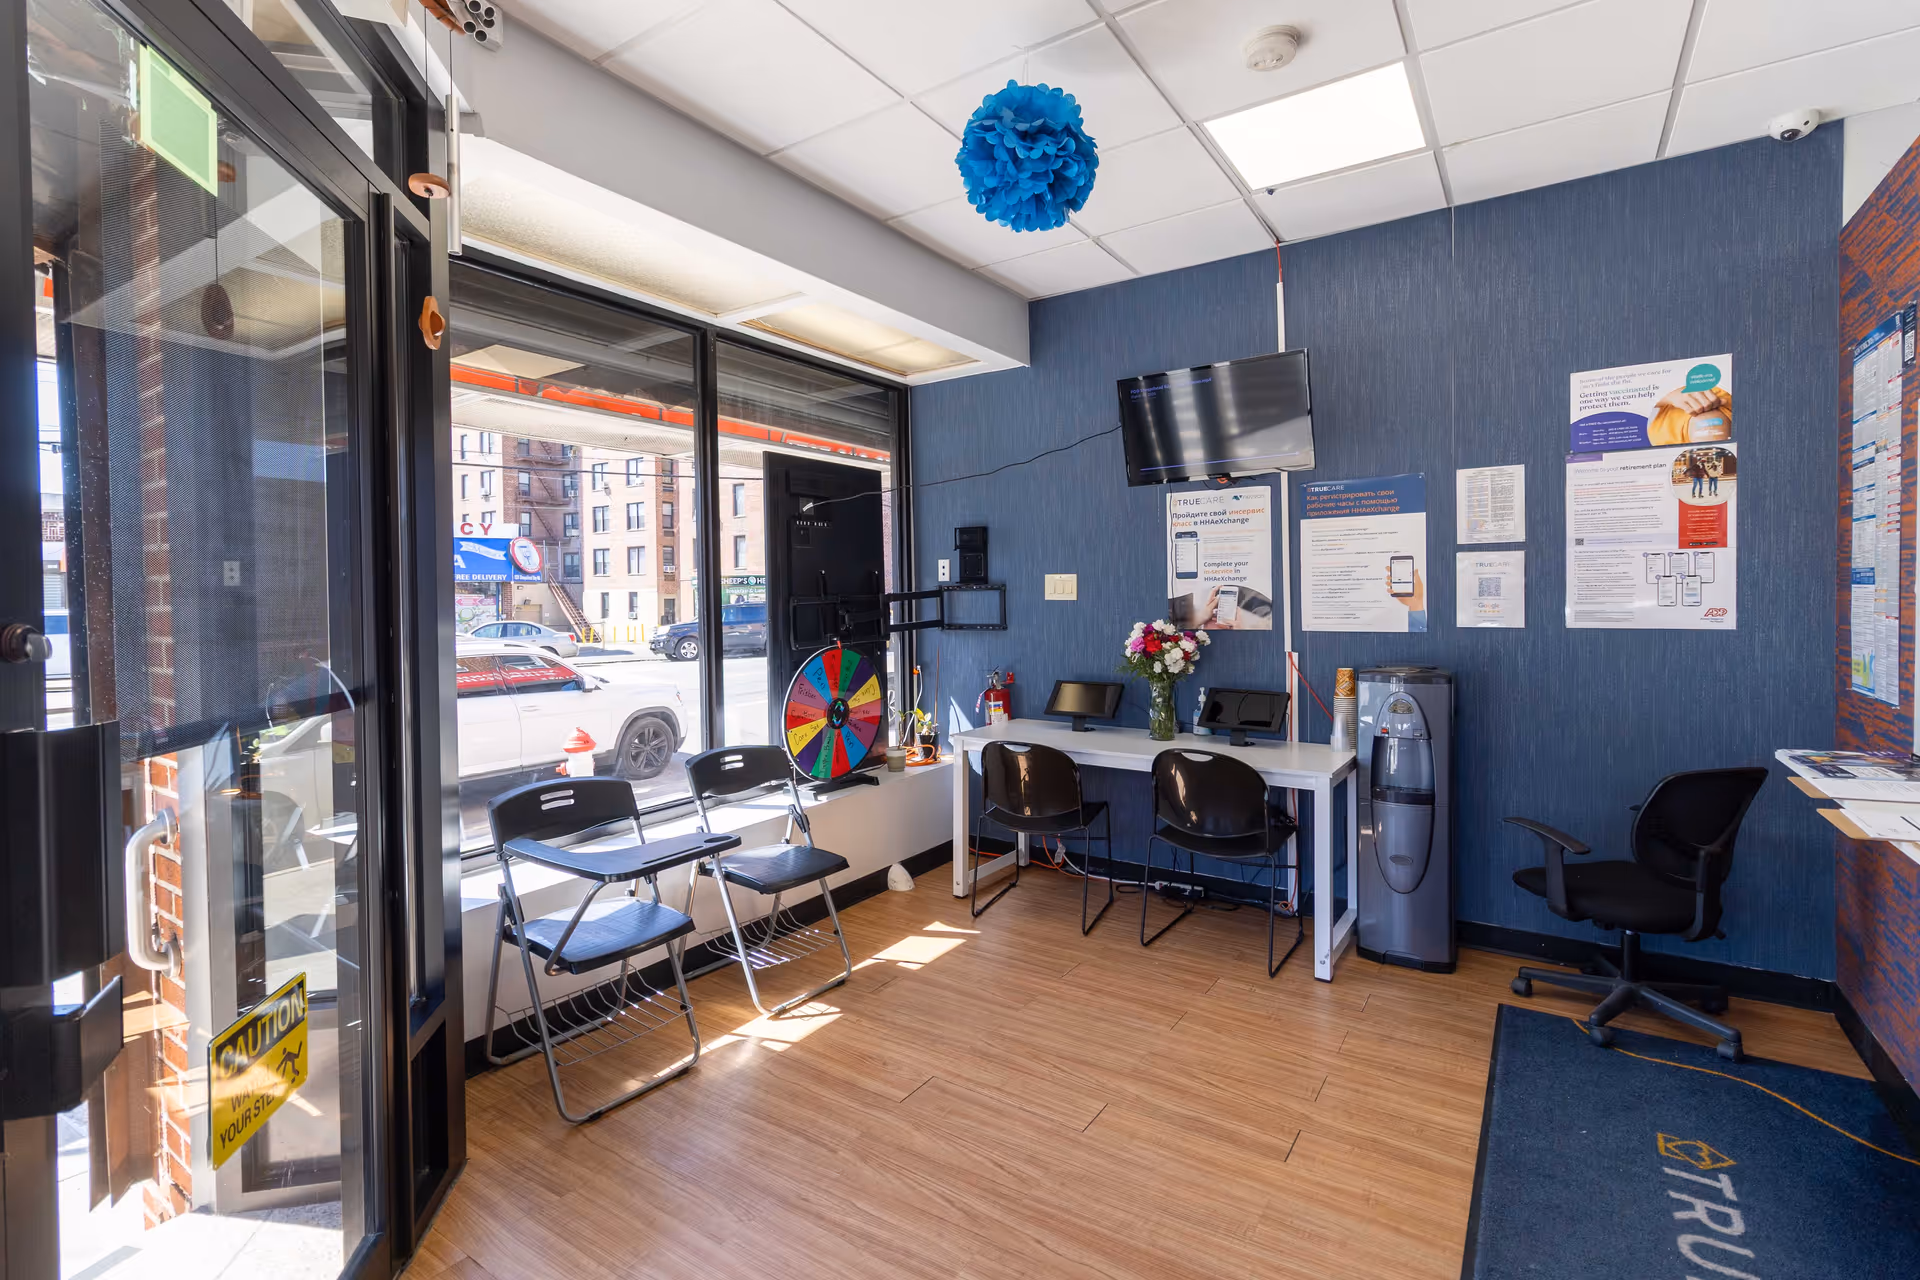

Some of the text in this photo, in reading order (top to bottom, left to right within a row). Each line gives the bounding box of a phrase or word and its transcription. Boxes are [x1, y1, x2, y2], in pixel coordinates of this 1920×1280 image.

[1580, 390, 1608, 398] Getting
[1608, 386, 1650, 394] vaccinated
[1580, 402, 1606, 411] protect
[1177, 496, 1224, 506] TRUECARE
[1320, 491, 1376, 501] регистрировать
[1307, 502, 1336, 510] рабочие
[1307, 505, 1400, 517] приложения HHAeXchange
[1172, 510, 1208, 520] Пройдите
[1229, 508, 1264, 516] инсервис
[1200, 517, 1250, 526] HHAeXchange
[1204, 574, 1247, 582] HHAeXchange
[1704, 608, 1728, 617] ADP
[812, 667, 826, 690] Pen
[220, 988, 305, 1079] CAUTION
[220, 1108, 252, 1150] YOUR
[1662, 1166, 1761, 1280] TRU
